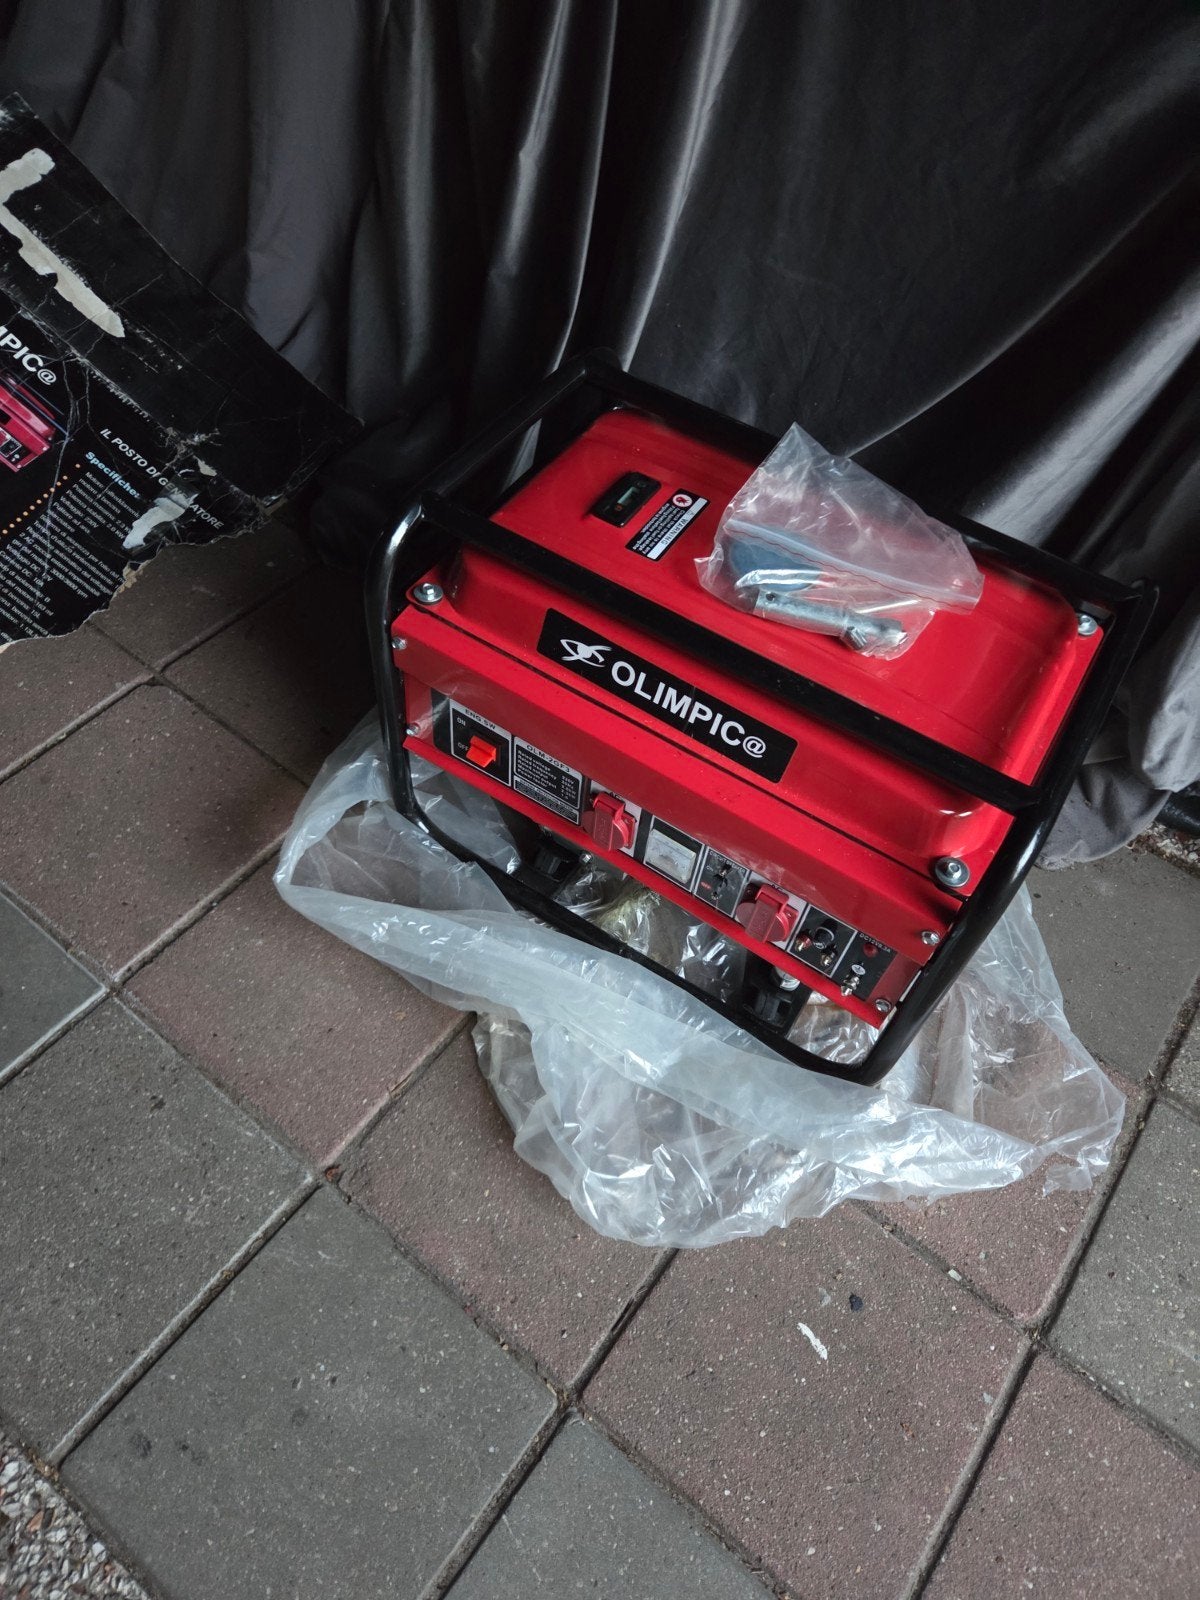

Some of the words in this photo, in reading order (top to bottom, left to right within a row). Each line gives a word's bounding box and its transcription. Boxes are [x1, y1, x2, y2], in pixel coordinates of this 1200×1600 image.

[0, 325, 57, 386] PIC@
[82, 449, 142, 500] Specifiche:
[98, 426, 113, 440] IL
[109, 435, 149, 469] POSTO
[144, 463, 162, 480] DI
[659, 516, 689, 547] WARNING
[611, 660, 767, 759] OLIMPIC@
